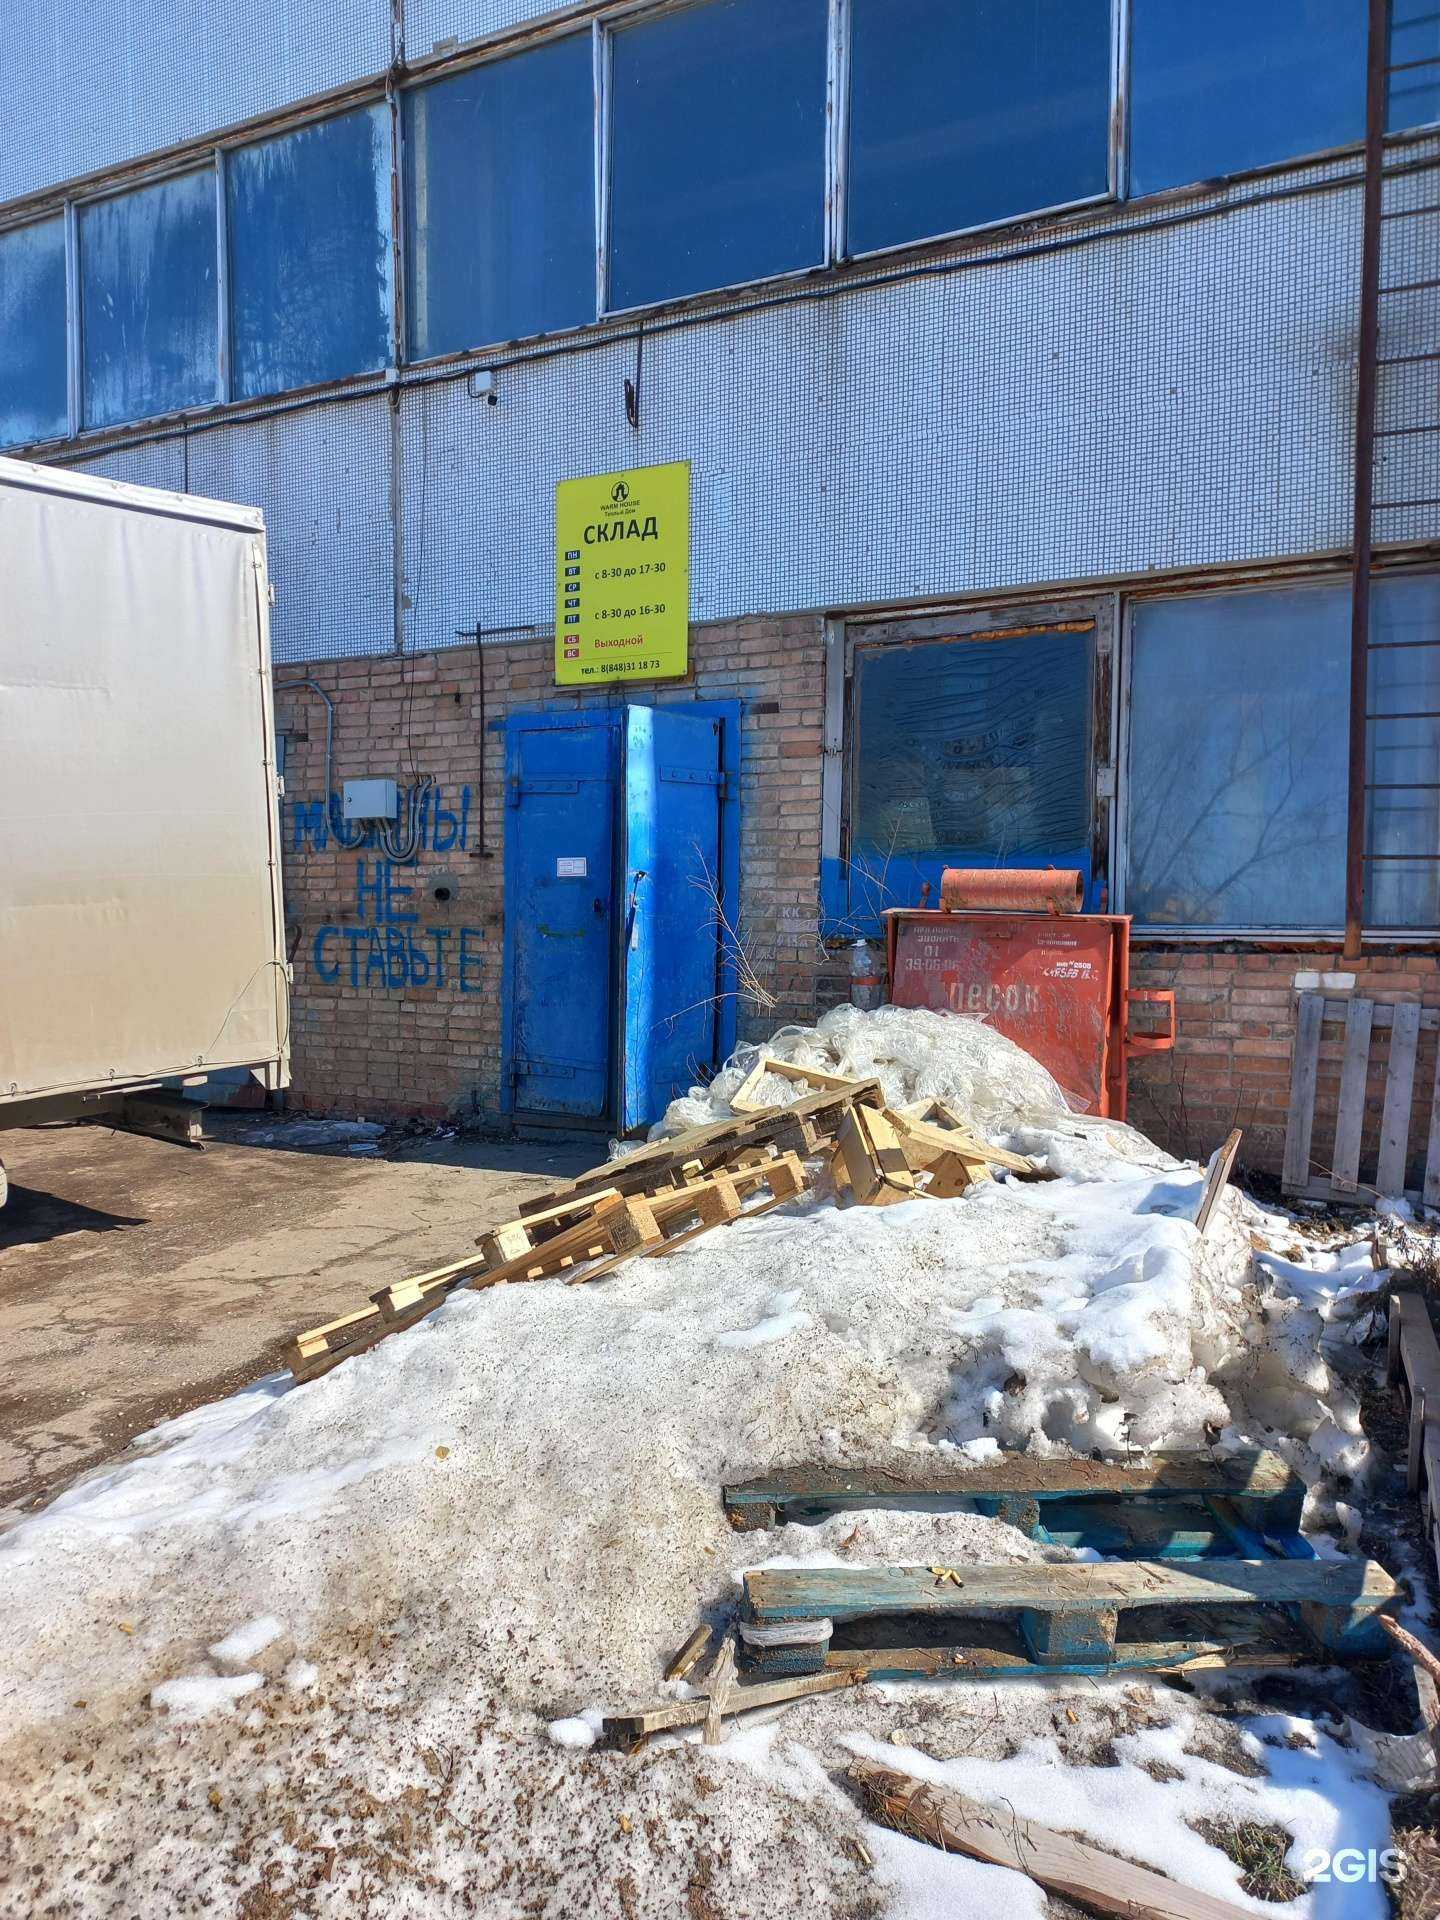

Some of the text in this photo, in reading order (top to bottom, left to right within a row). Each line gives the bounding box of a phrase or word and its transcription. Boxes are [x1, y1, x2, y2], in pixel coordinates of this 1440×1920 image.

[600, 499, 641, 511] WARM HOUSE
[583, 516, 659, 545] СКЛАД
[567, 551, 578, 560] ПН
[567, 567, 577, 575] ВТ
[601, 567, 622, 579] 8-30
[623, 567, 637, 578] до
[639, 562, 666, 574] 17-30
[567, 583, 577, 592] СР
[567, 599, 577, 607] ЧТ
[601, 608, 622, 620] 8-30
[623, 608, 637, 619] до
[639, 603, 666, 615] 16-30
[567, 615, 577, 623] ПТ
[567, 635, 577, 643] СБ
[594, 634, 644, 648] Выходной
[567, 649, 577, 657] ВС
[600, 661, 635, 674] 8(848)31
[638, 661, 648, 670] 18
[651, 660, 660, 669] 73
[356, 856, 420, 924] НЕ
[313, 926, 485, 993] СТАВЬТЕ
